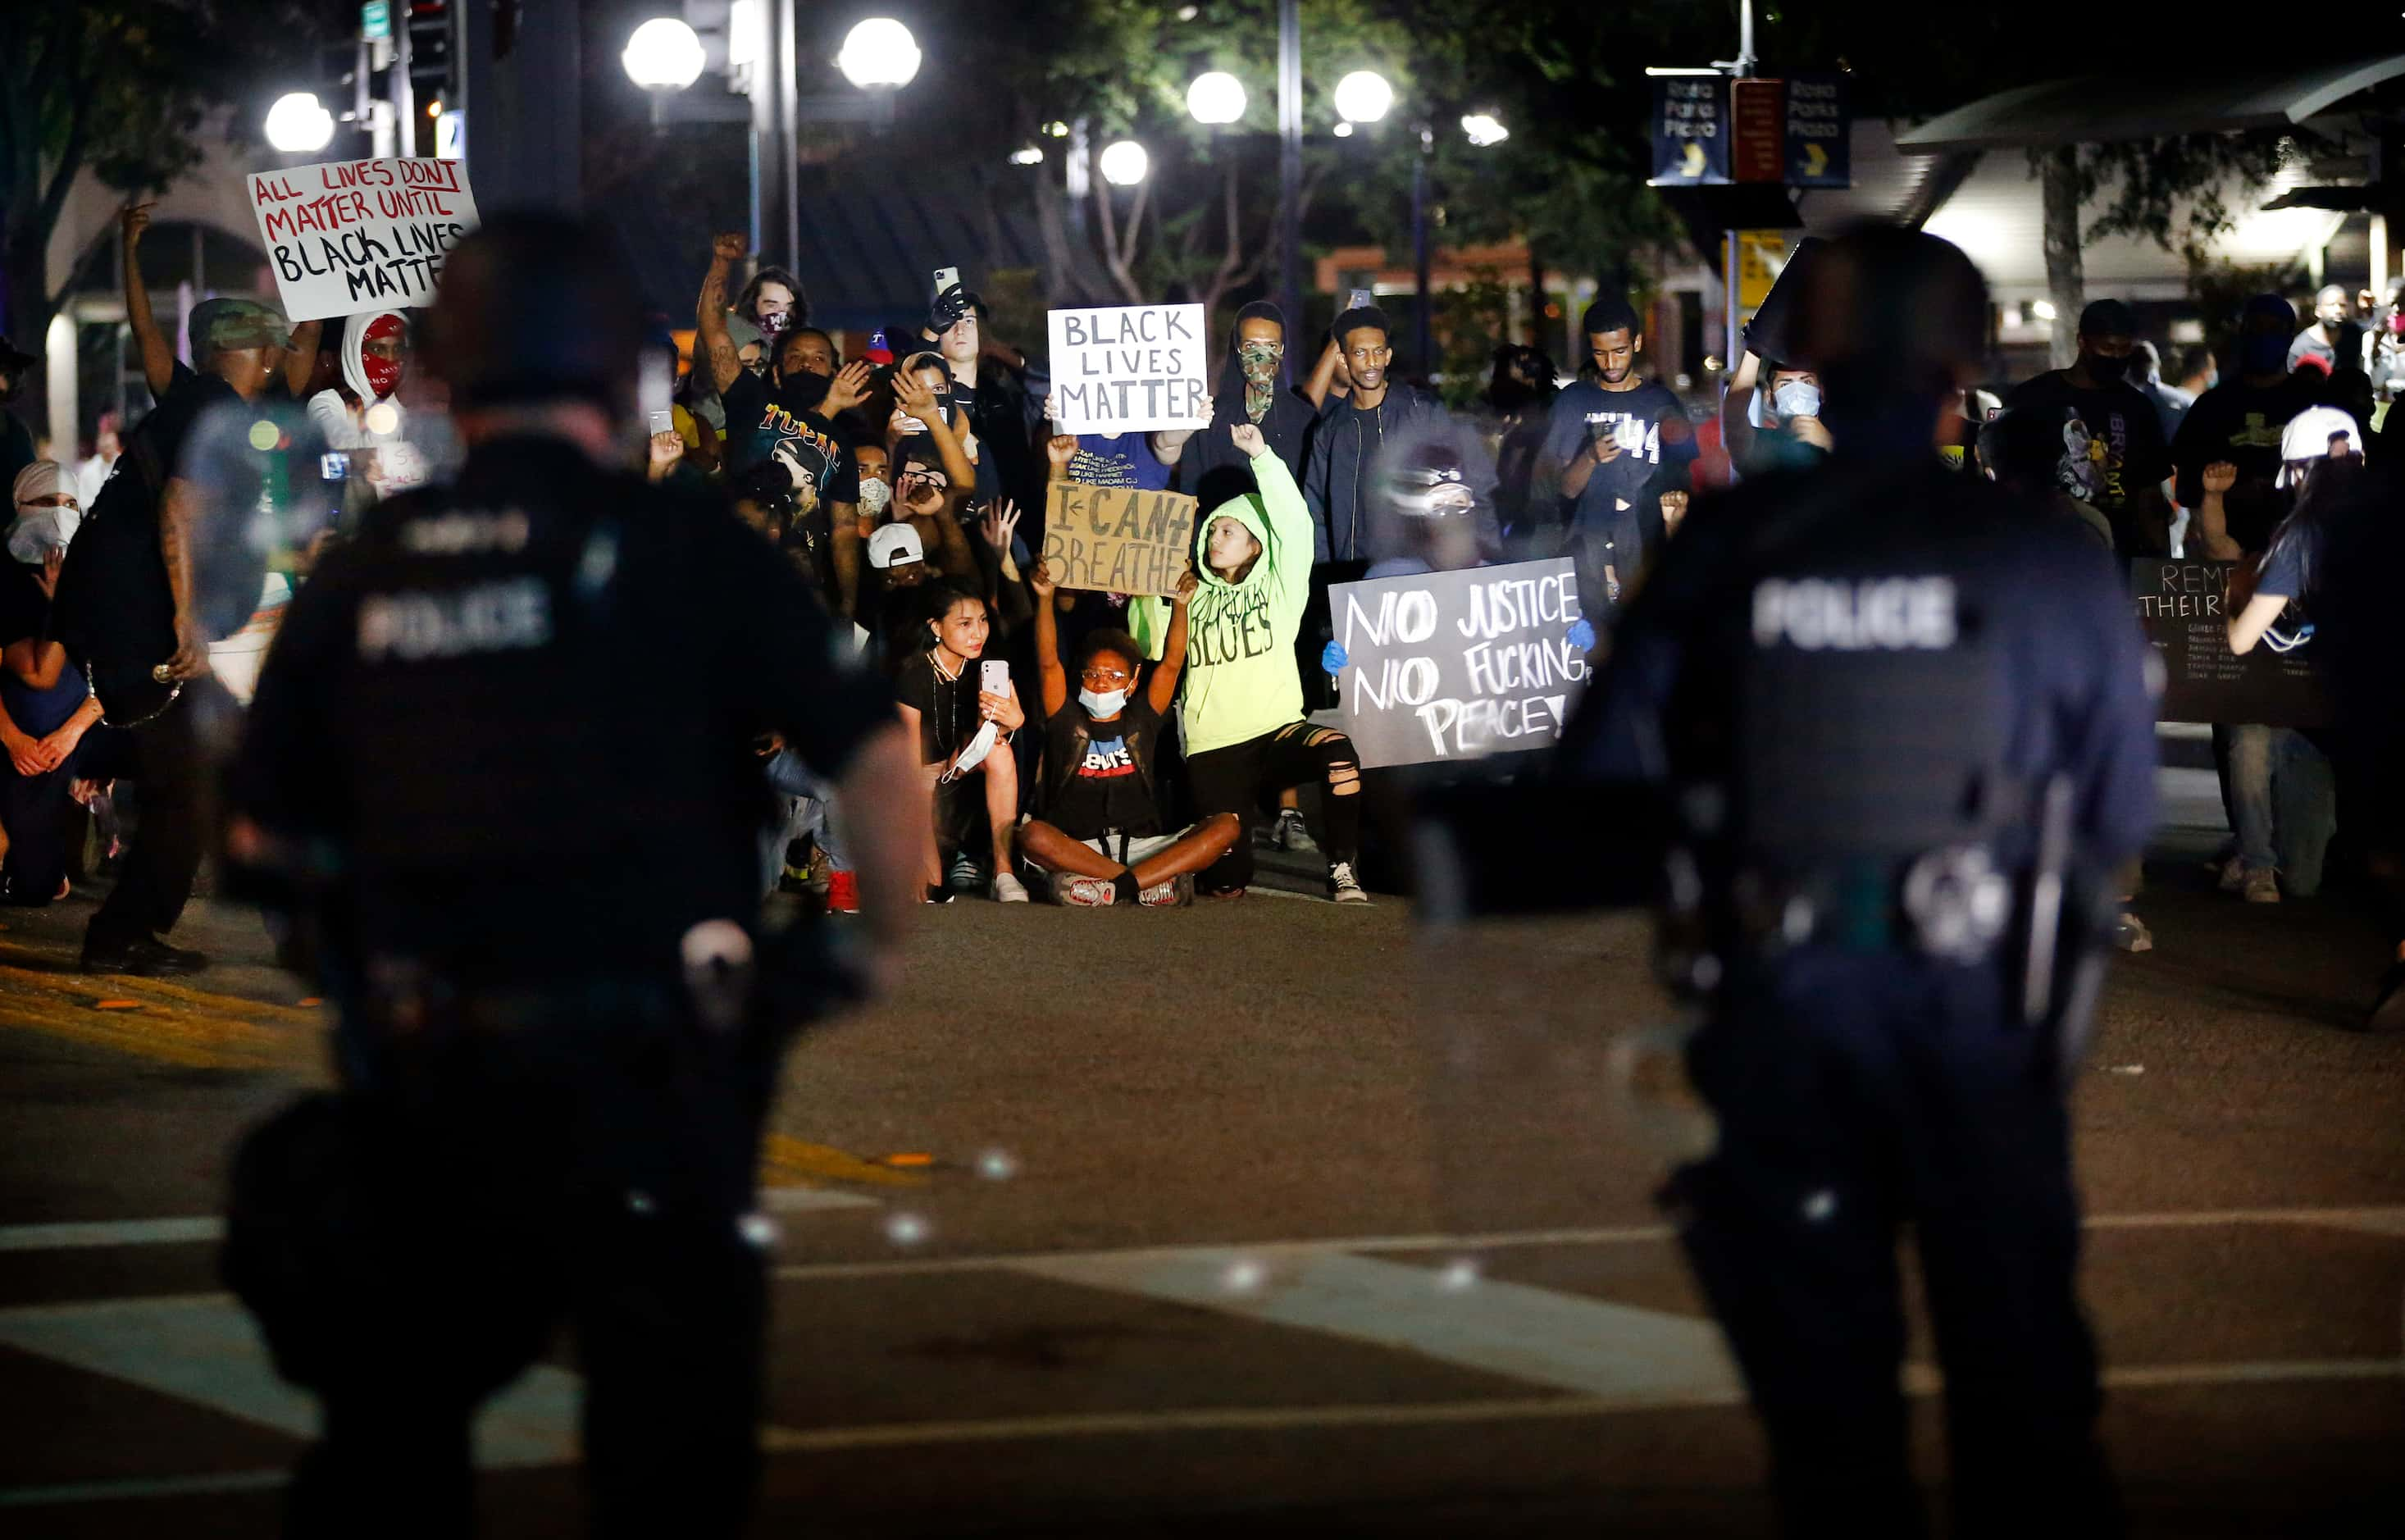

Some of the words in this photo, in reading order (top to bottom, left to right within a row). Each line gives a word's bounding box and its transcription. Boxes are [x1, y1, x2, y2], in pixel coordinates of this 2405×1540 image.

[256, 176, 303, 206] ALL
[321, 161, 394, 189] LIVES
[265, 190, 374, 243] MATTER
[377, 190, 453, 219] UNTIL
[275, 226, 389, 281] BLACK
[1065, 310, 1193, 346] BLACK
[1082, 349, 1182, 376] LIVES
[1060, 378, 1205, 421] MATTER
[1051, 485, 1078, 531] I
[1041, 531, 1186, 595] BREATHE
[1346, 590, 1437, 654] NO
[1457, 572, 1581, 639] JUSTICE
[1751, 574, 1958, 651] POLICE
[2139, 595, 2221, 617] THEIR
[1355, 657, 1439, 716] NO
